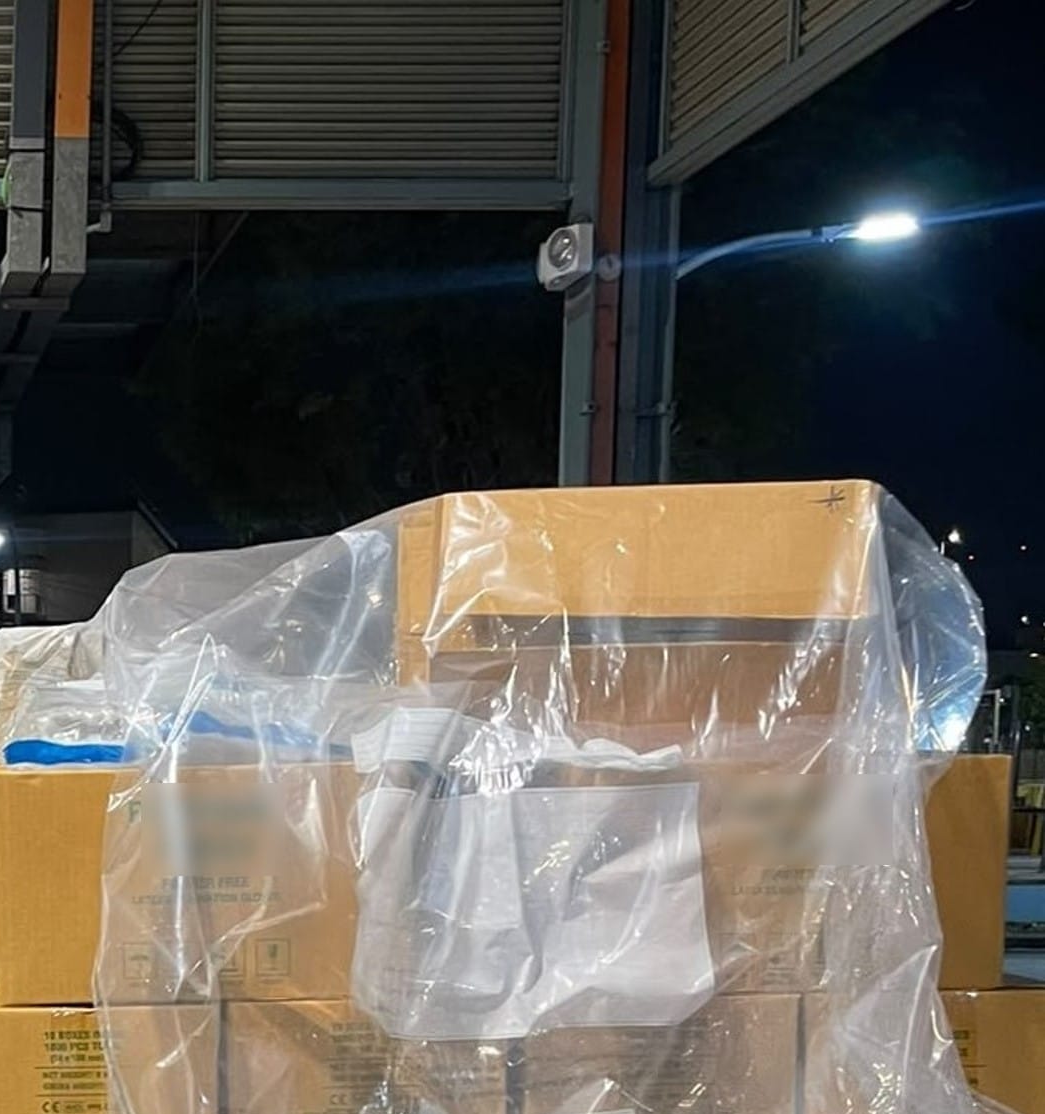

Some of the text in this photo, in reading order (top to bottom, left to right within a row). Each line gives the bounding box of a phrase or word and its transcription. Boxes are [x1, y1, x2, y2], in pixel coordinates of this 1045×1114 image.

[44, 1031, 90, 1040] 10 BOXES
[44, 1042, 90, 1051] 1000 PCS
